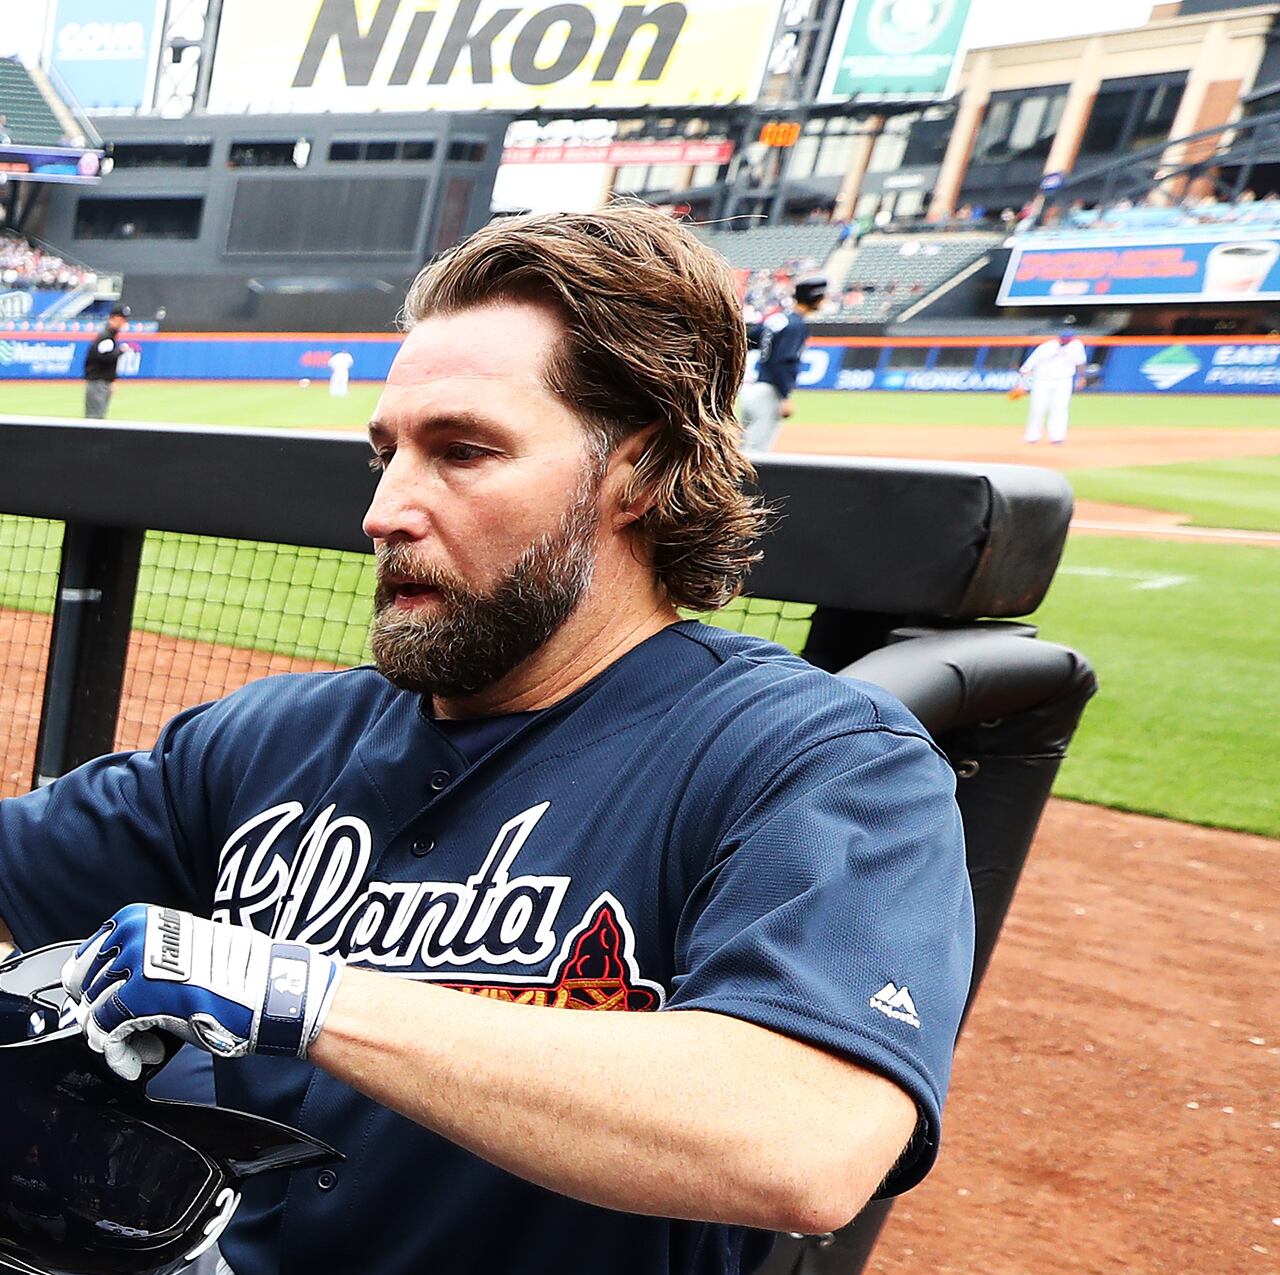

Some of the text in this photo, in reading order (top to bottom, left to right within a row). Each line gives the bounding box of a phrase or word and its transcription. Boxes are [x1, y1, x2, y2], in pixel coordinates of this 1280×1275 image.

[291, 0, 687, 88] Nikon
[13, 340, 76, 364] National
[213, 800, 562, 967] Atlanta
